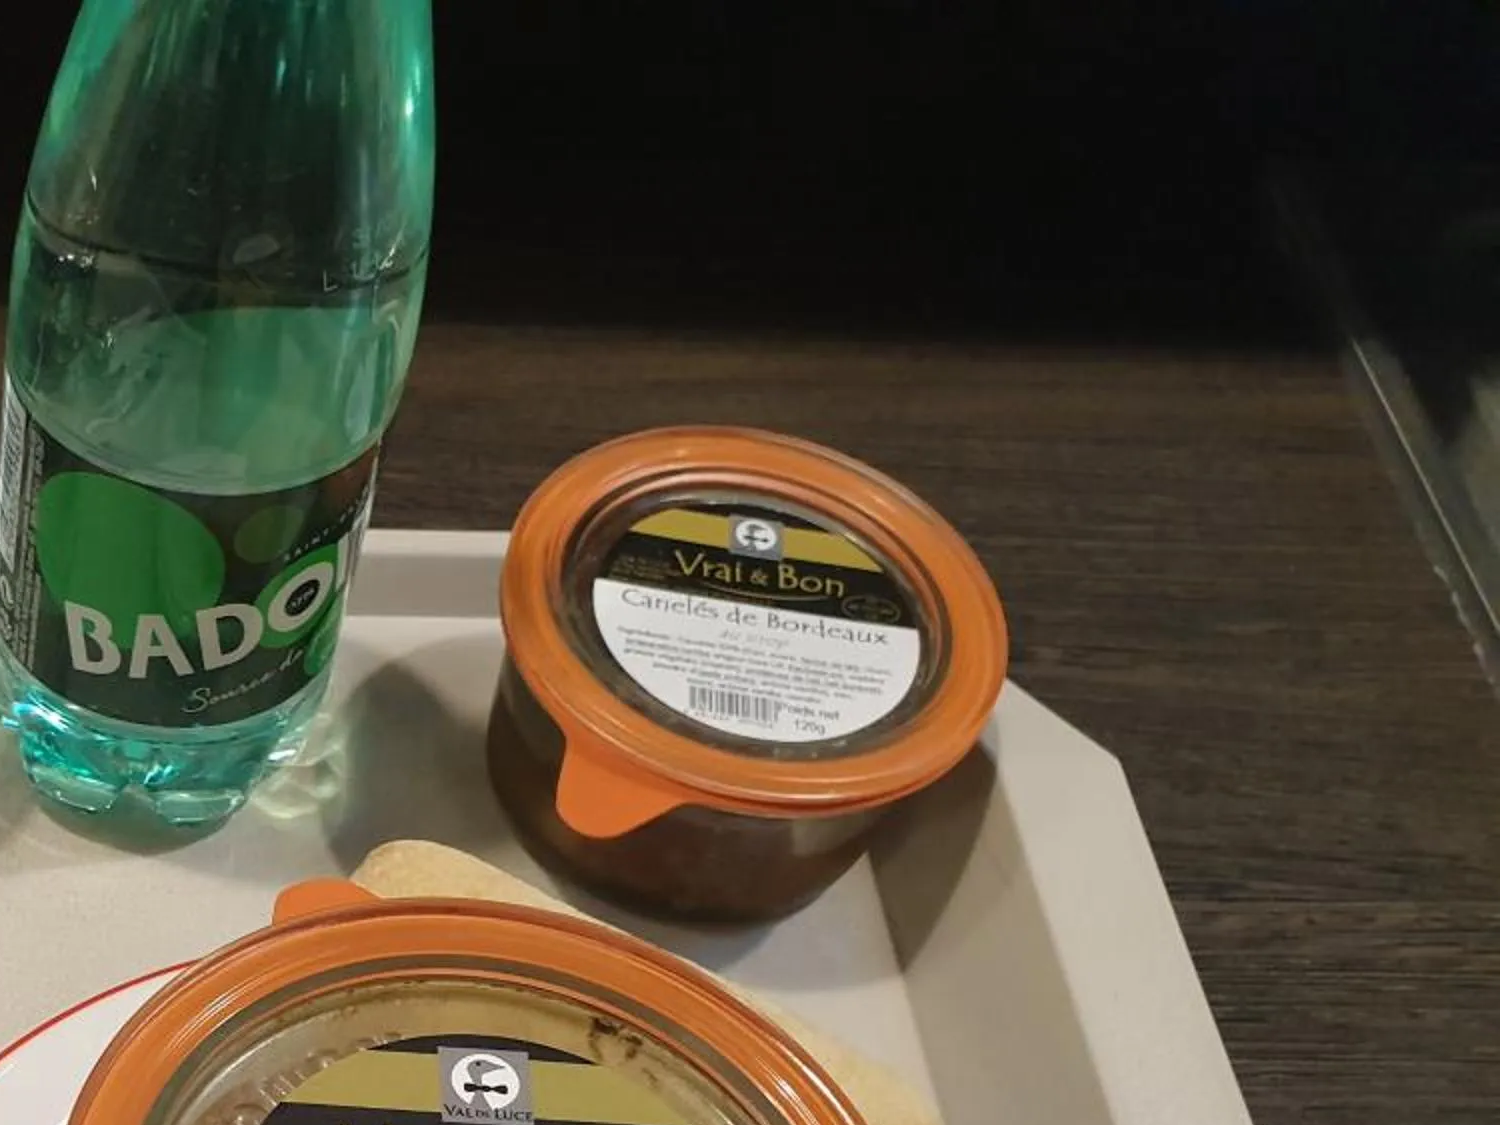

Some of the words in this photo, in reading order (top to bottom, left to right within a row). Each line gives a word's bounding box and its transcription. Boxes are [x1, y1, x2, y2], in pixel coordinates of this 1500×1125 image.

[675, 550, 741, 583] Vrai
[750, 568, 769, 587] &
[778, 565, 845, 597] Bon
[726, 605, 759, 627] de
[767, 613, 890, 647] Bordeaux
[443, 1103, 474, 1118] VAL
[494, 1108, 534, 1121] LUCE
